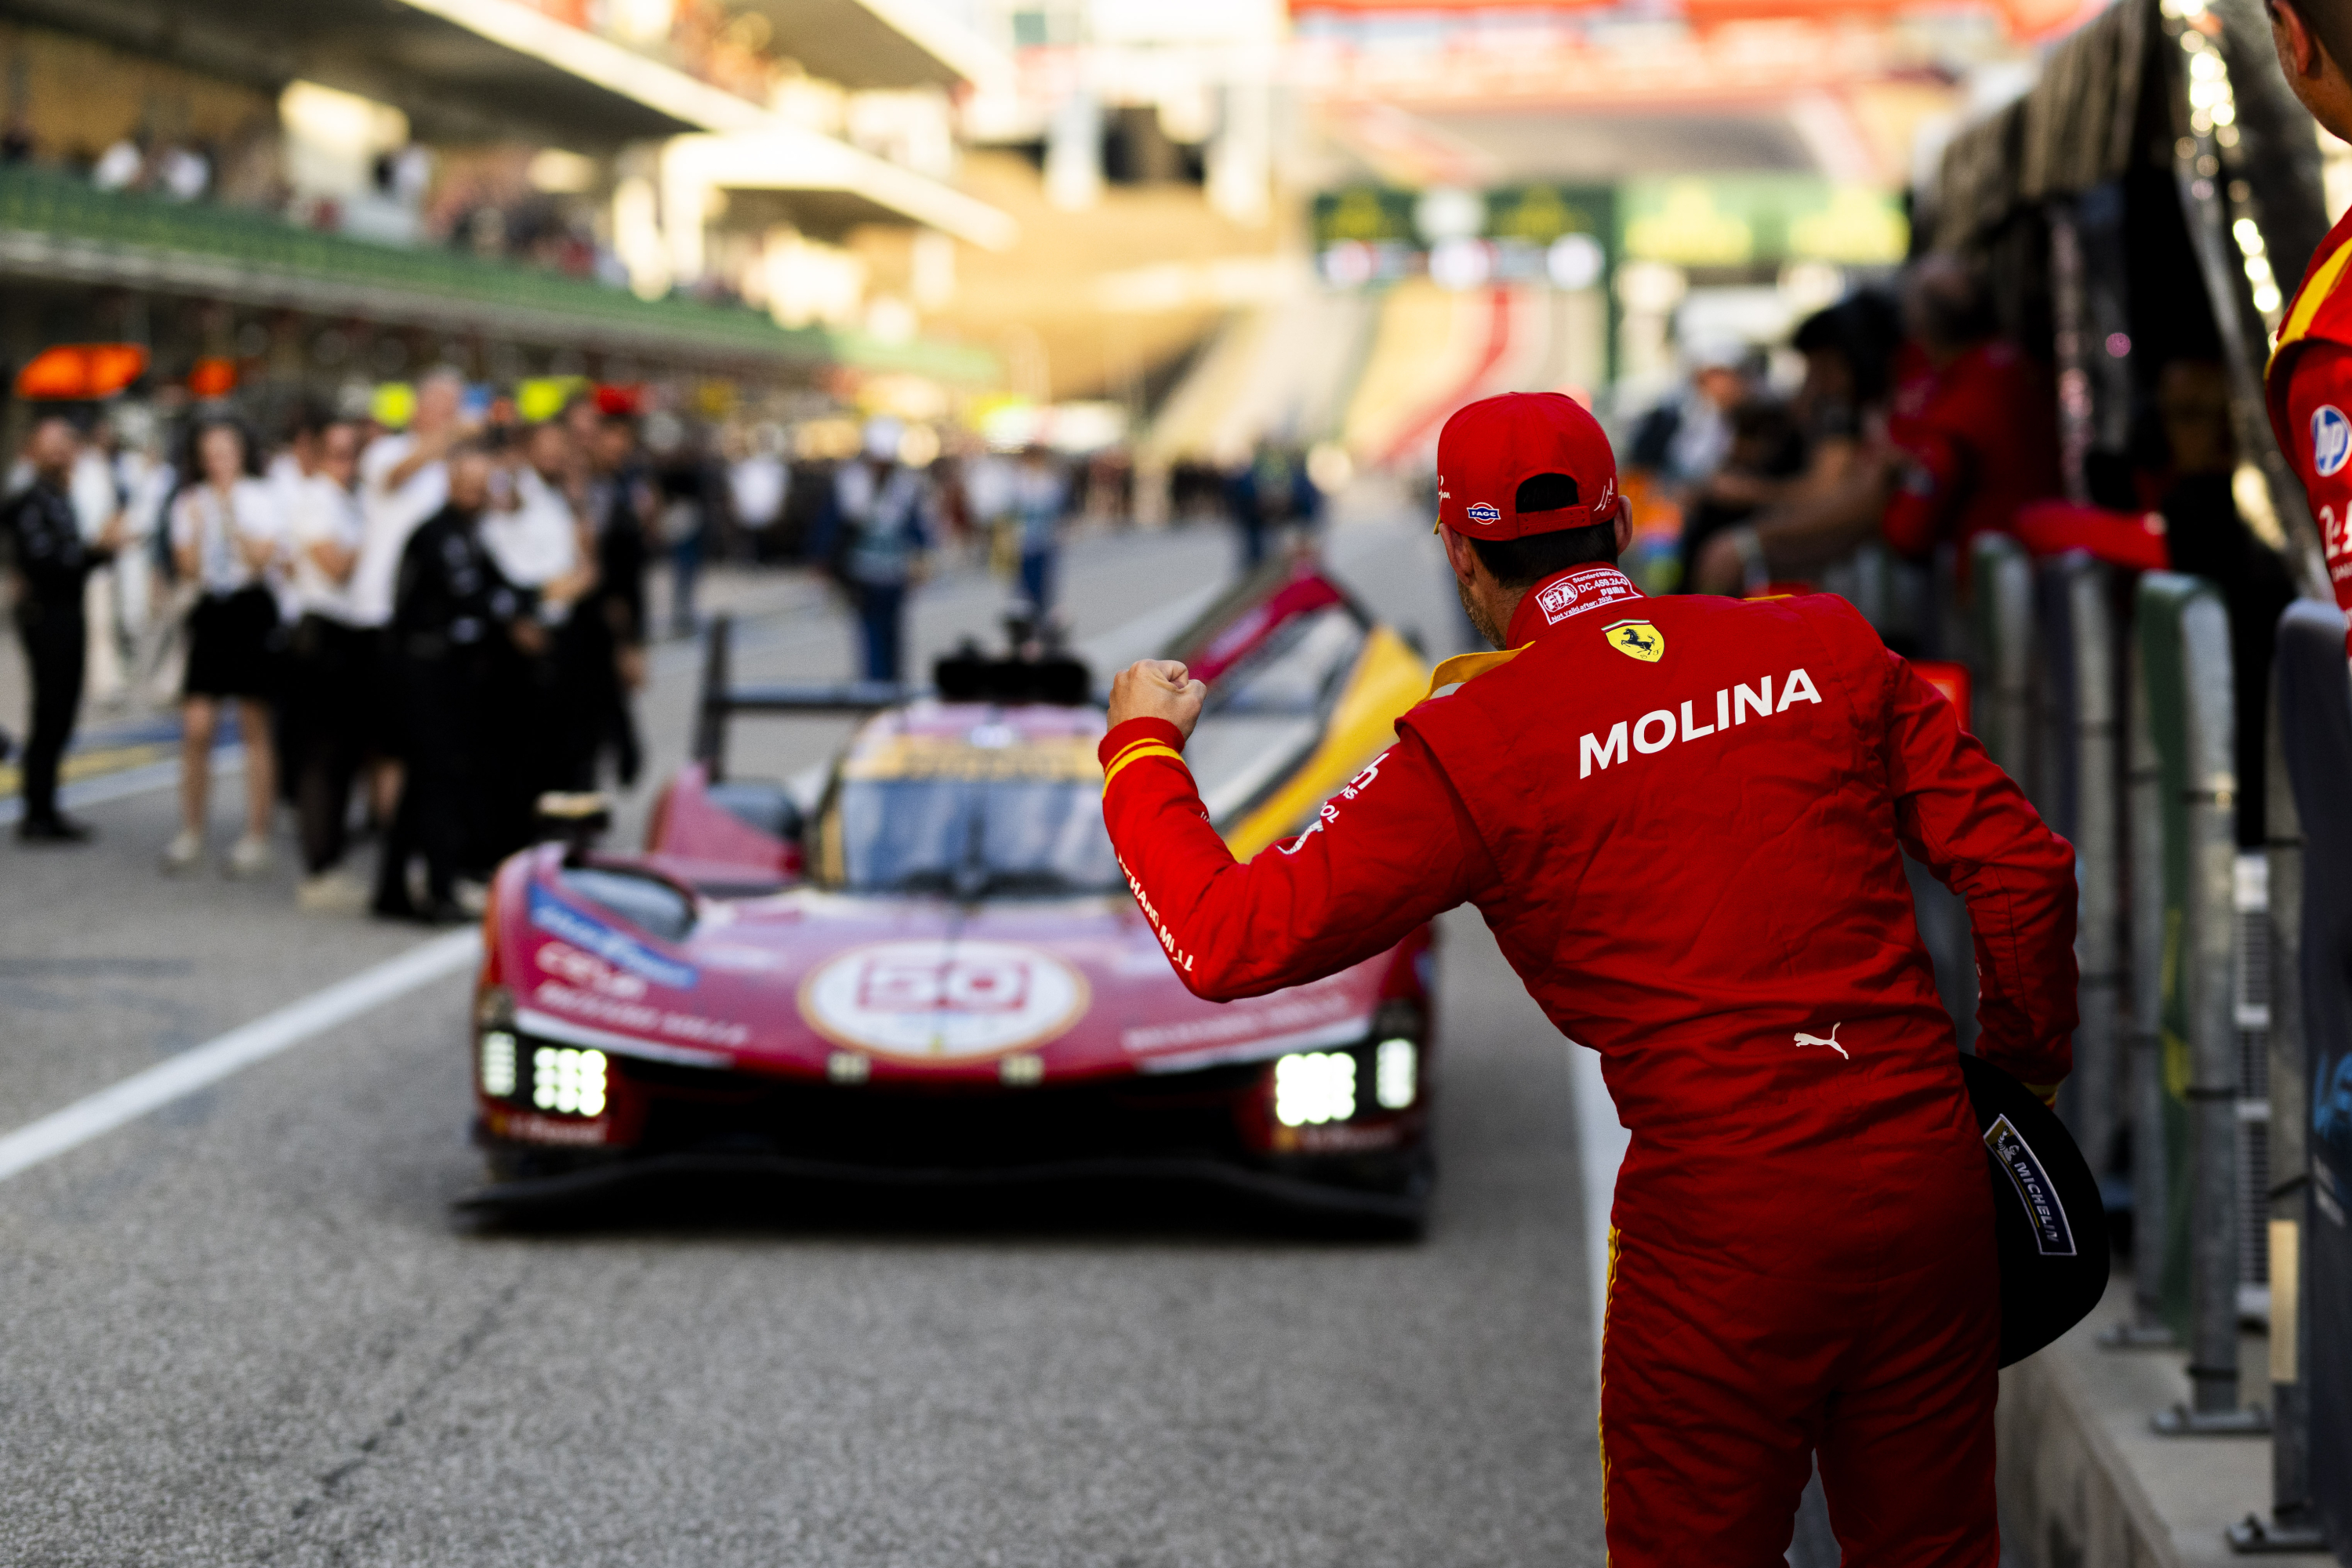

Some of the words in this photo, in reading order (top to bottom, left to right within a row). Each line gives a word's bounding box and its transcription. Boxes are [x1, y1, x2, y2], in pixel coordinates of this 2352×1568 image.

[1573, 572, 1600, 583] Standard
[1544, 585, 1576, 611] FIA
[1552, 613, 1565, 622] Not
[1564, 606, 1580, 615] valid
[1580, 668, 1823, 780] MOLINA
[2014, 1161, 2060, 1243] MICHELIN
